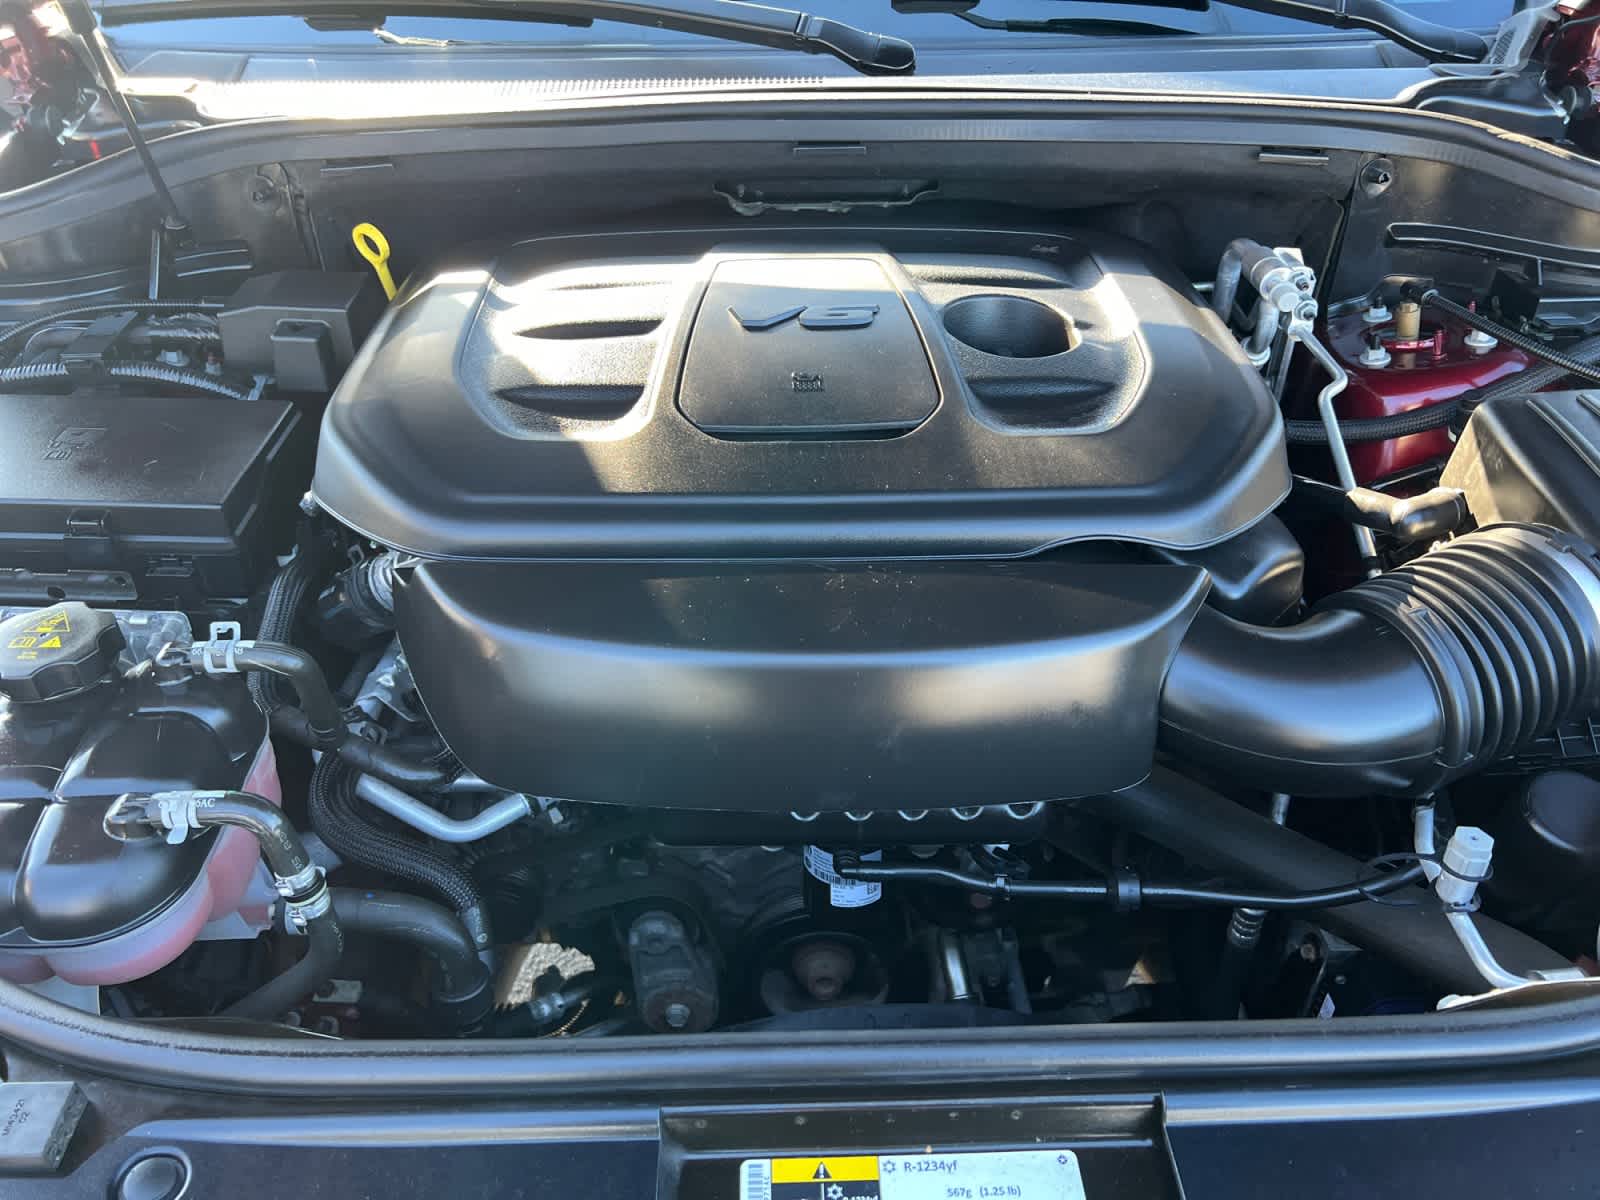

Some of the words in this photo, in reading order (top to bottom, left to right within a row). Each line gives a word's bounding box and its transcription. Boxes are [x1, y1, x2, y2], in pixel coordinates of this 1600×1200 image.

[727, 304, 880, 332] V6
[904, 1160, 958, 1174] R-1234yf
[946, 1187, 973, 1199] 567g
[979, 1186, 1006, 1198] (1.25
[1007, 1185, 1022, 1197] lb)
